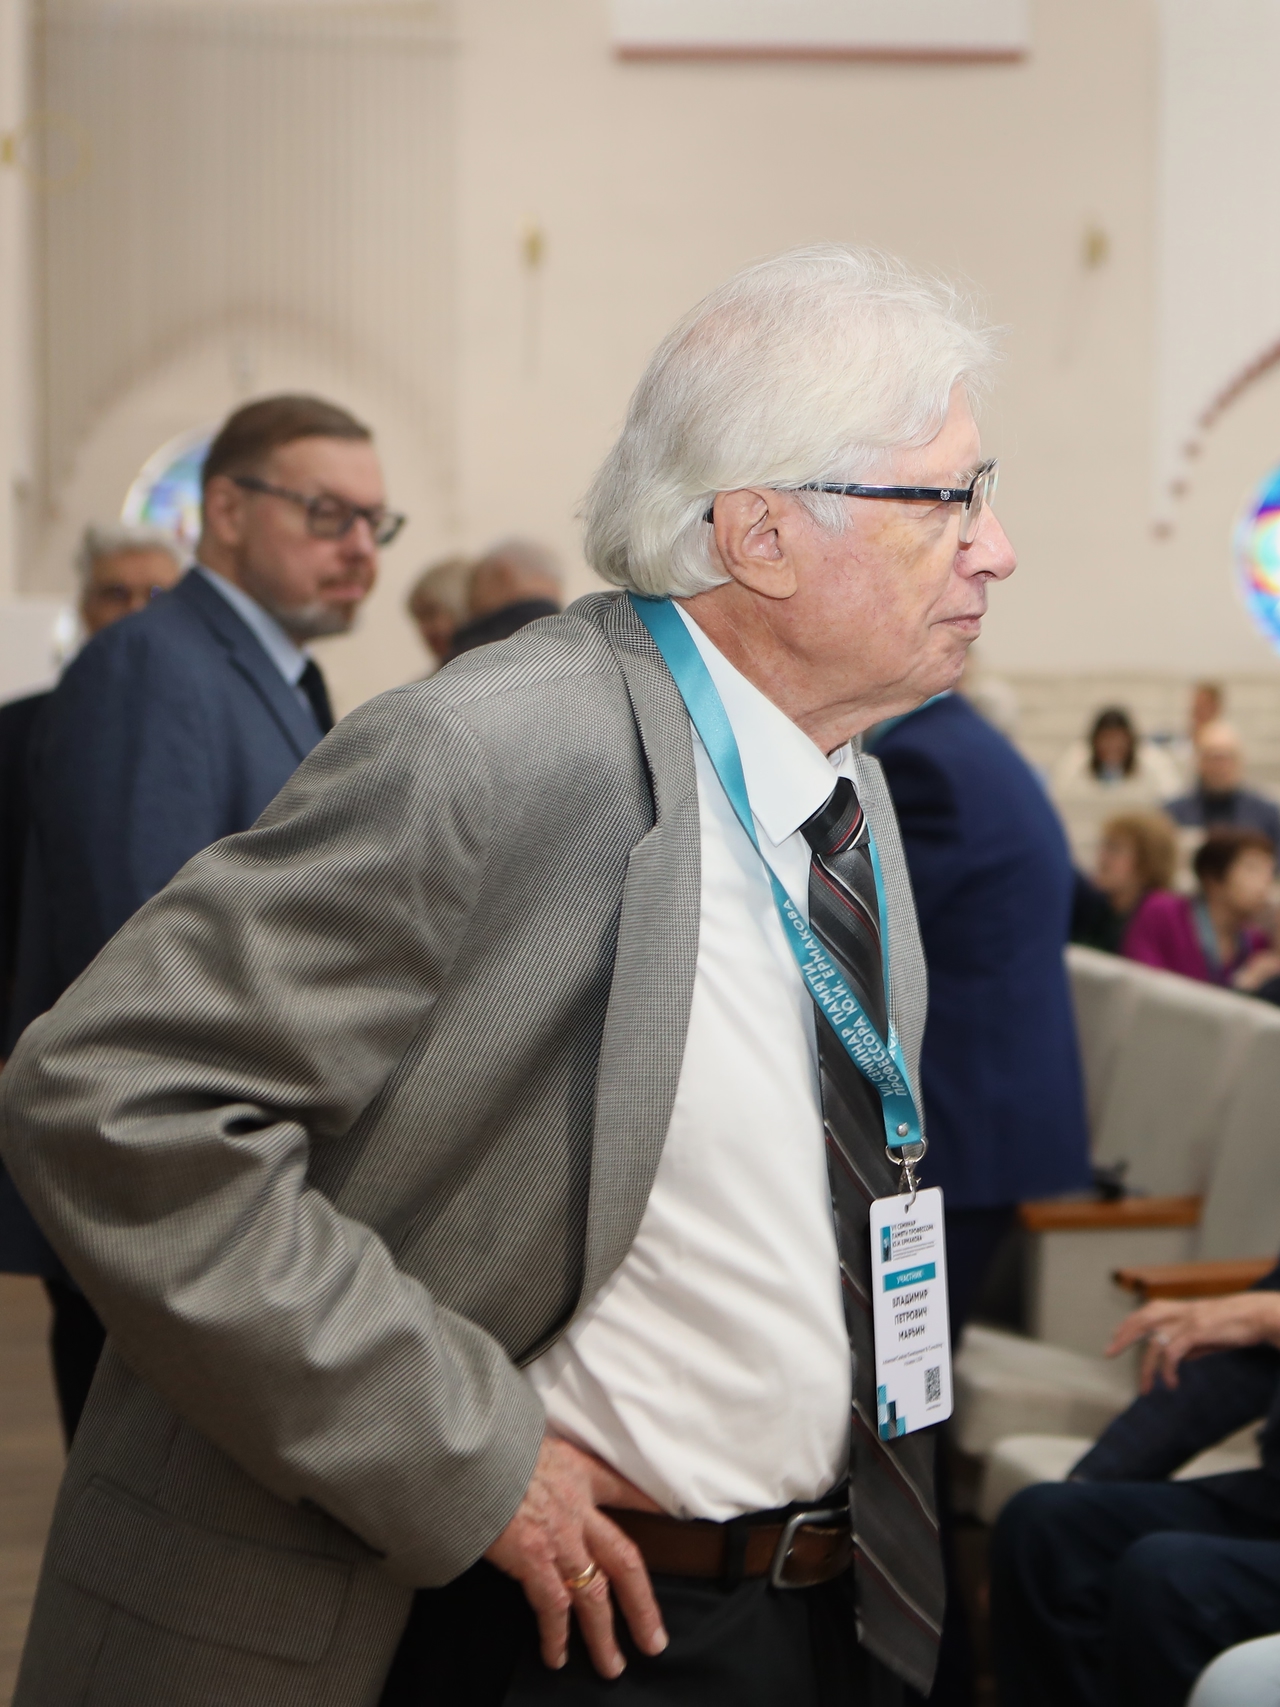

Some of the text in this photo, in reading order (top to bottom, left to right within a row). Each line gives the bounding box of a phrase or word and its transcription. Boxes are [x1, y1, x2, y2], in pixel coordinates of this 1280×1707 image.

[783, 899, 907, 1096] ПРОФЕССОРА Ю.И. ЕРМАКОВА
[802, 962, 894, 1097] VII СЕМИНАР ПАМЯТИ
[896, 1269, 924, 1285] УЧАСТНИК
[892, 1288, 929, 1309] ВЛАДИМИР
[894, 1306, 928, 1326] ПЕТРОВИЧ
[898, 1324, 926, 1342] МАРЬИН
